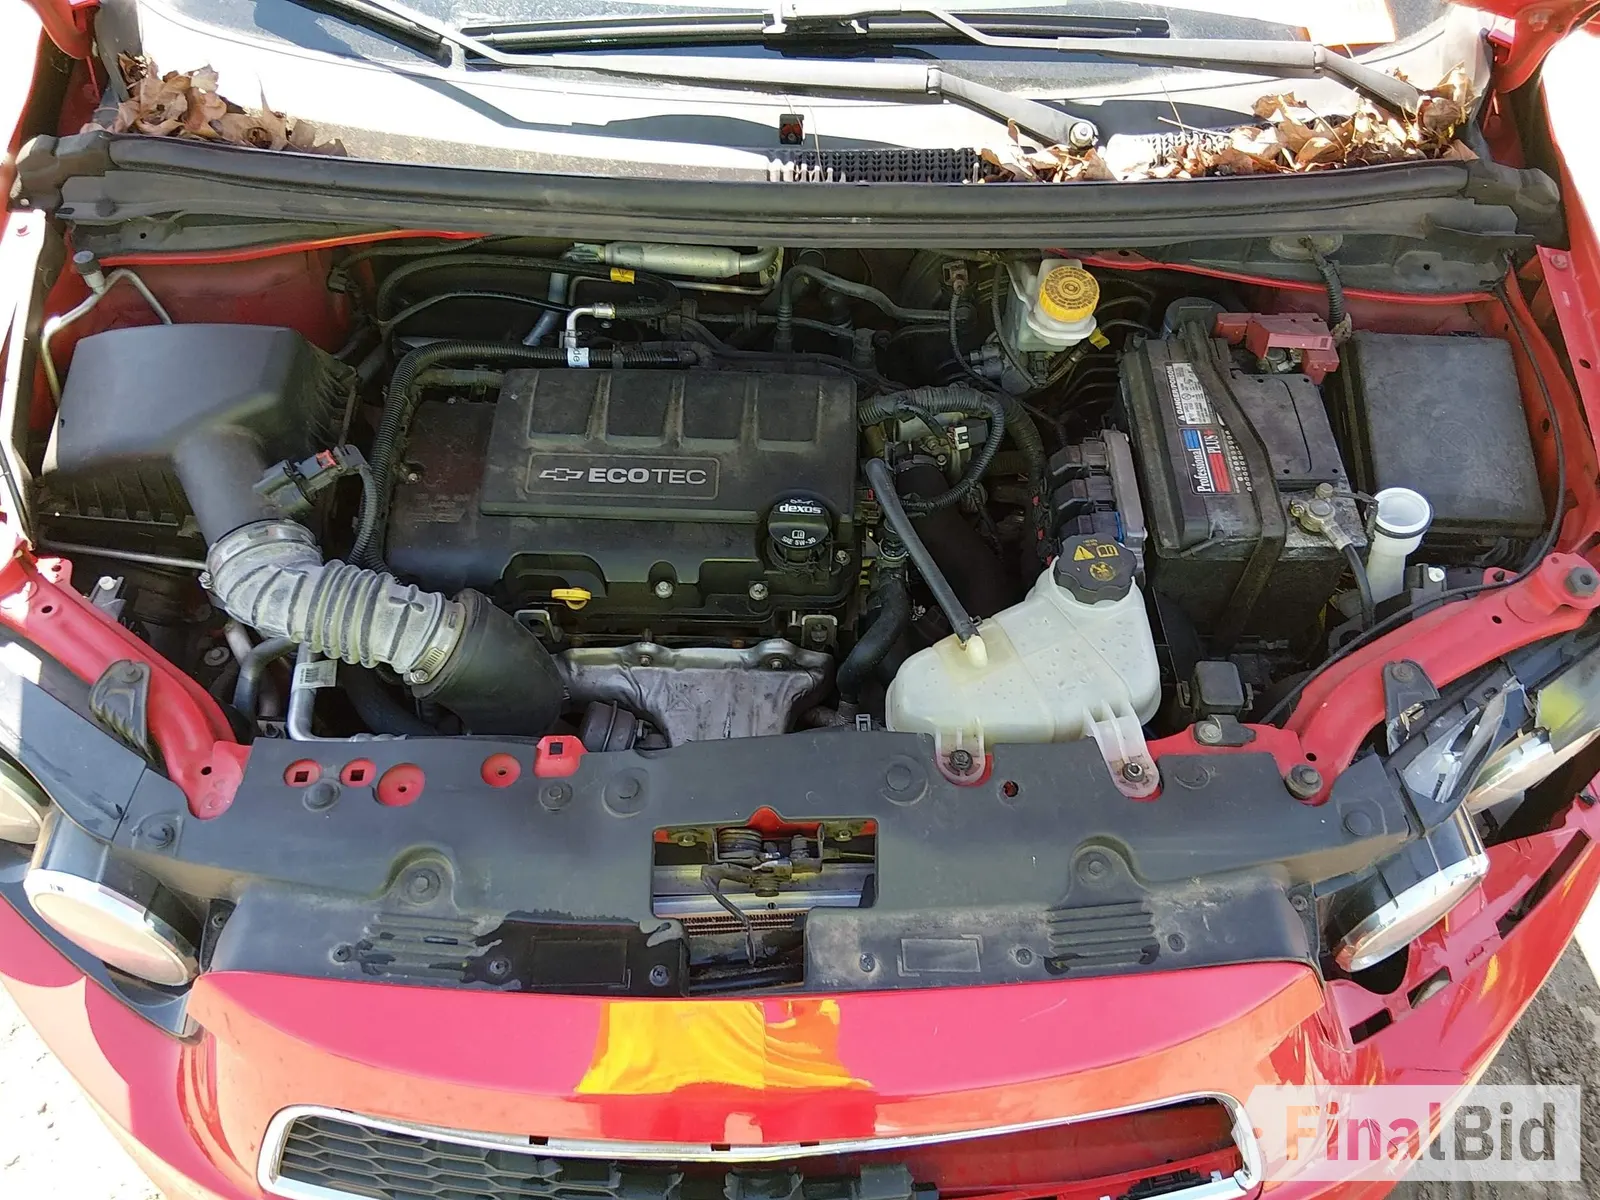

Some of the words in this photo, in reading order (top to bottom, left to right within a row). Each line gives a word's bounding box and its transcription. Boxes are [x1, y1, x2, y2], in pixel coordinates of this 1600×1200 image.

[1166, 365, 1185, 415] DANGER/POISON
[1203, 434, 1222, 454] PLUS
[588, 467, 707, 485] ECOTEC
[1188, 448, 1212, 493] Professional
[779, 503, 823, 514] dexos
[794, 536, 817, 546] 5W-30
